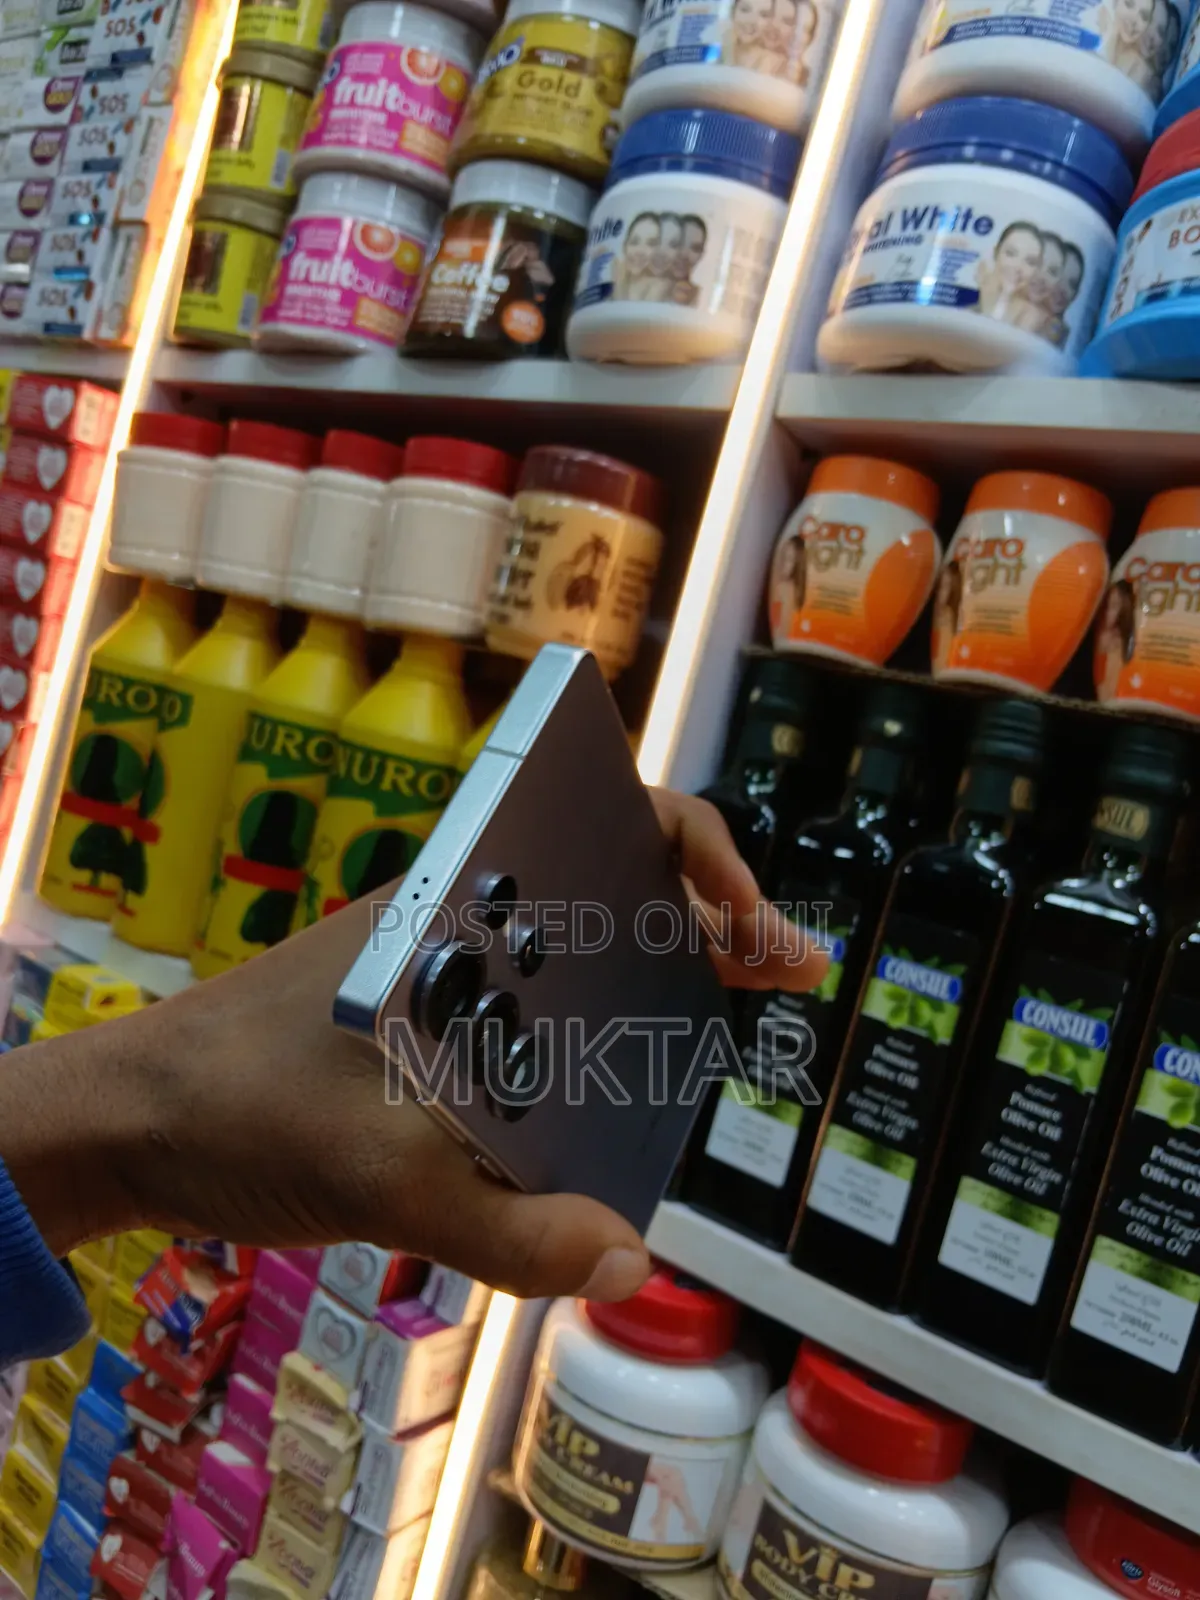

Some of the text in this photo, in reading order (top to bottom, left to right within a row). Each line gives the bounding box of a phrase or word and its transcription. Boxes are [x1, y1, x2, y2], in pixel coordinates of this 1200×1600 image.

[104, 16, 137, 38] SOS
[517, 69, 583, 99] Gold
[900, 204, 994, 237] White
[884, 956, 953, 1001] CONSUL
[1021, 999, 1098, 1048] CONSUL
[1163, 1047, 1200, 1086] CON
